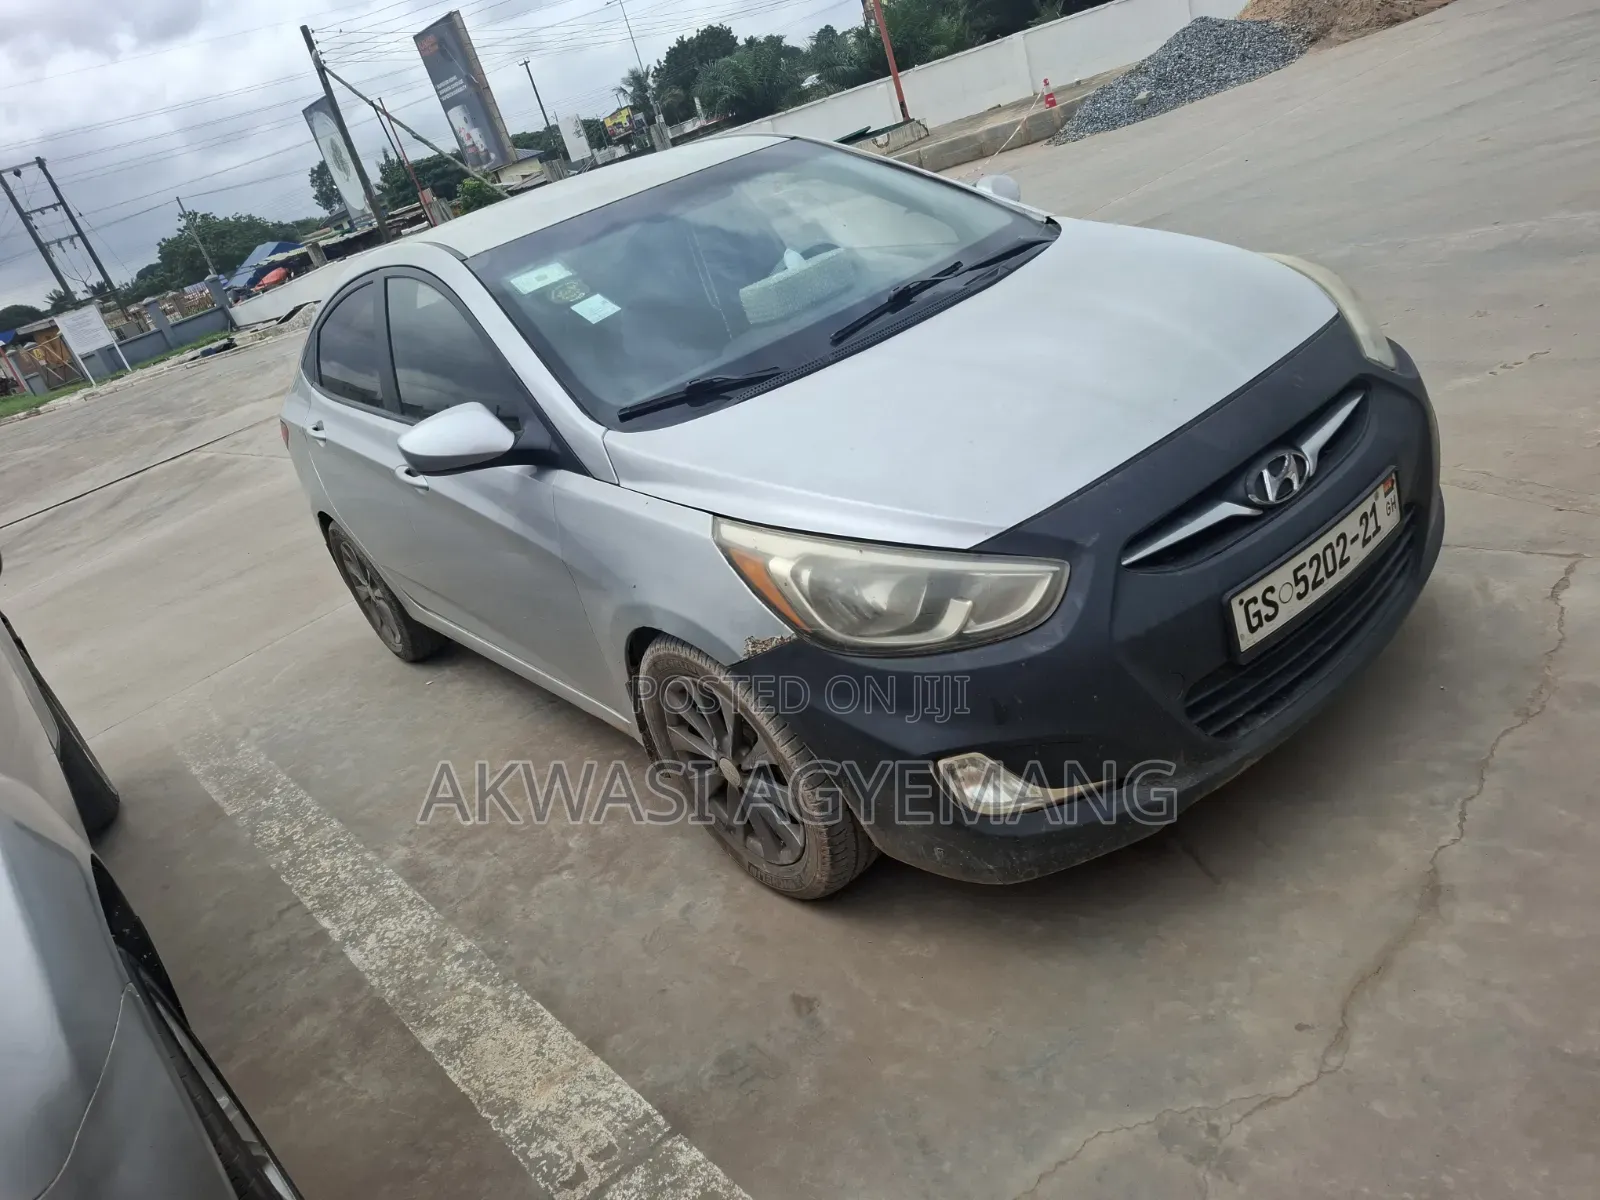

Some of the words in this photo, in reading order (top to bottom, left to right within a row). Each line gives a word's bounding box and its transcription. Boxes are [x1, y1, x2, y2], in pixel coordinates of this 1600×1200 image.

[1386, 495, 1397, 517] GH
[1243, 585, 1279, 634] GS
[1292, 502, 1382, 601] 5202-21
